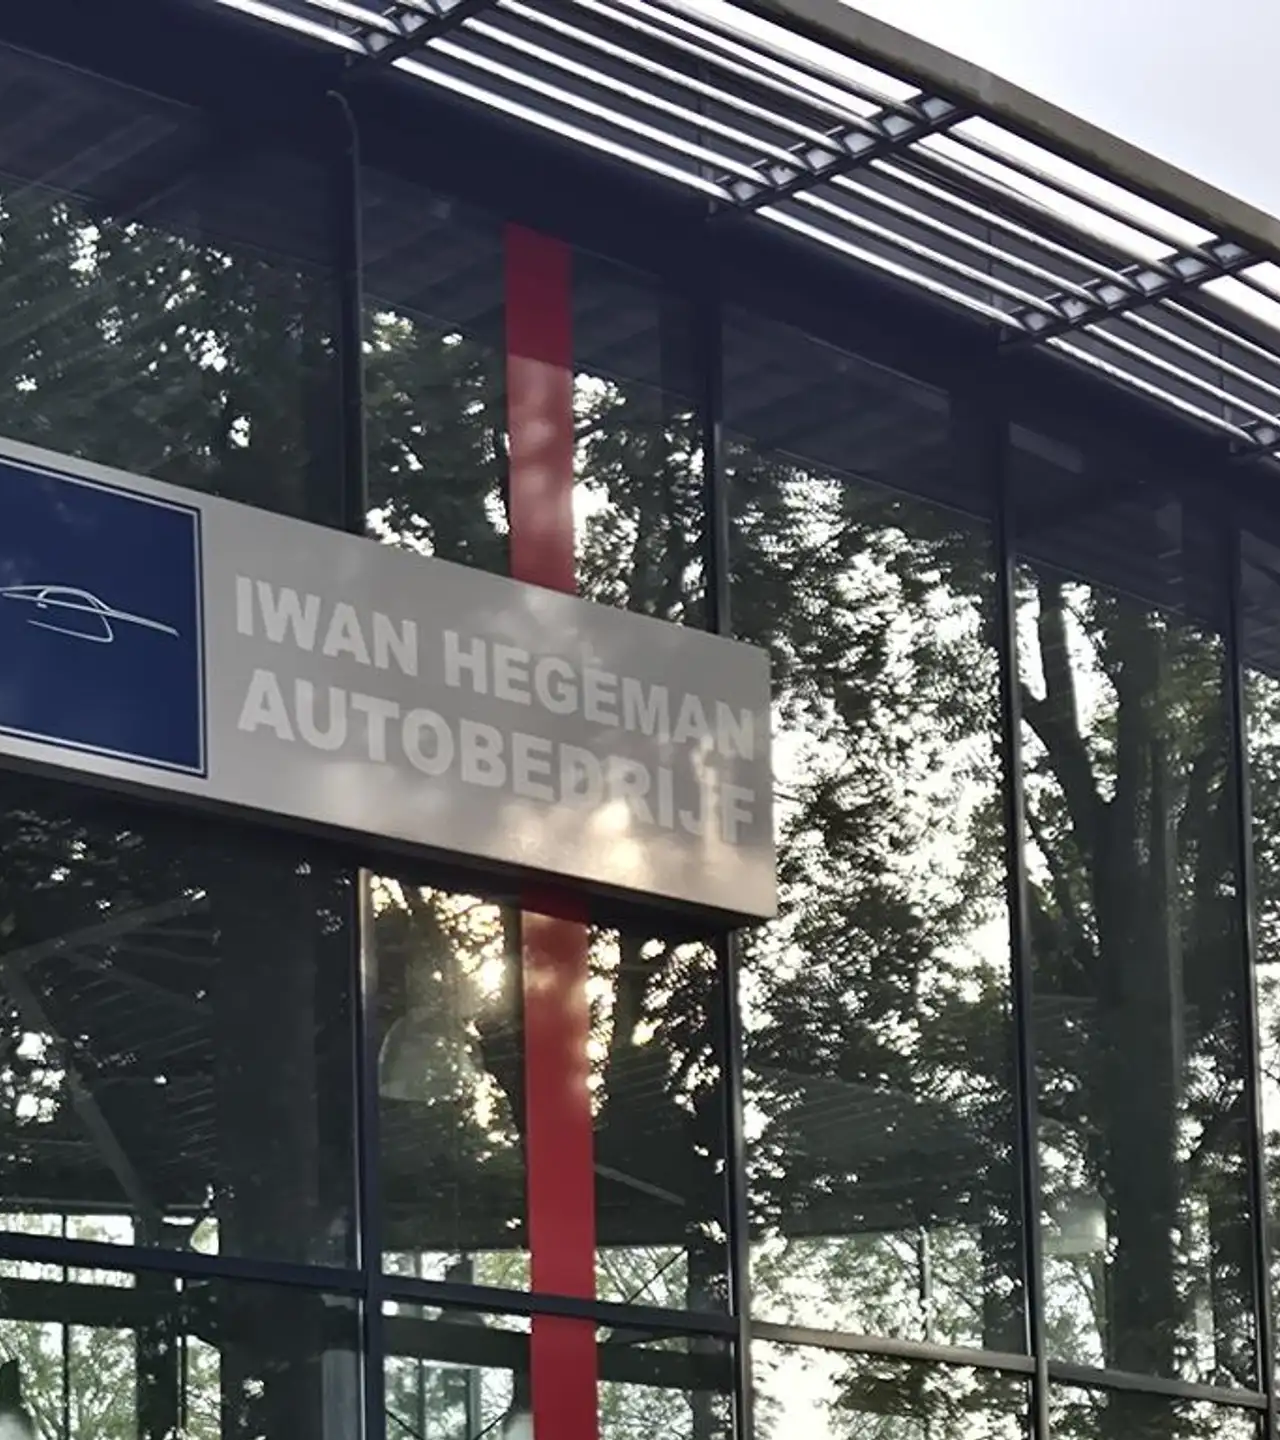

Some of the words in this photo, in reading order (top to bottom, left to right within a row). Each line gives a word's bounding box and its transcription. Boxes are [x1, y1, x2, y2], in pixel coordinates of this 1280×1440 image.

[234, 575, 418, 677] IWAN
[443, 630, 755, 760] HEGEMAN
[237, 668, 756, 843] AUTOBEDRIJF
